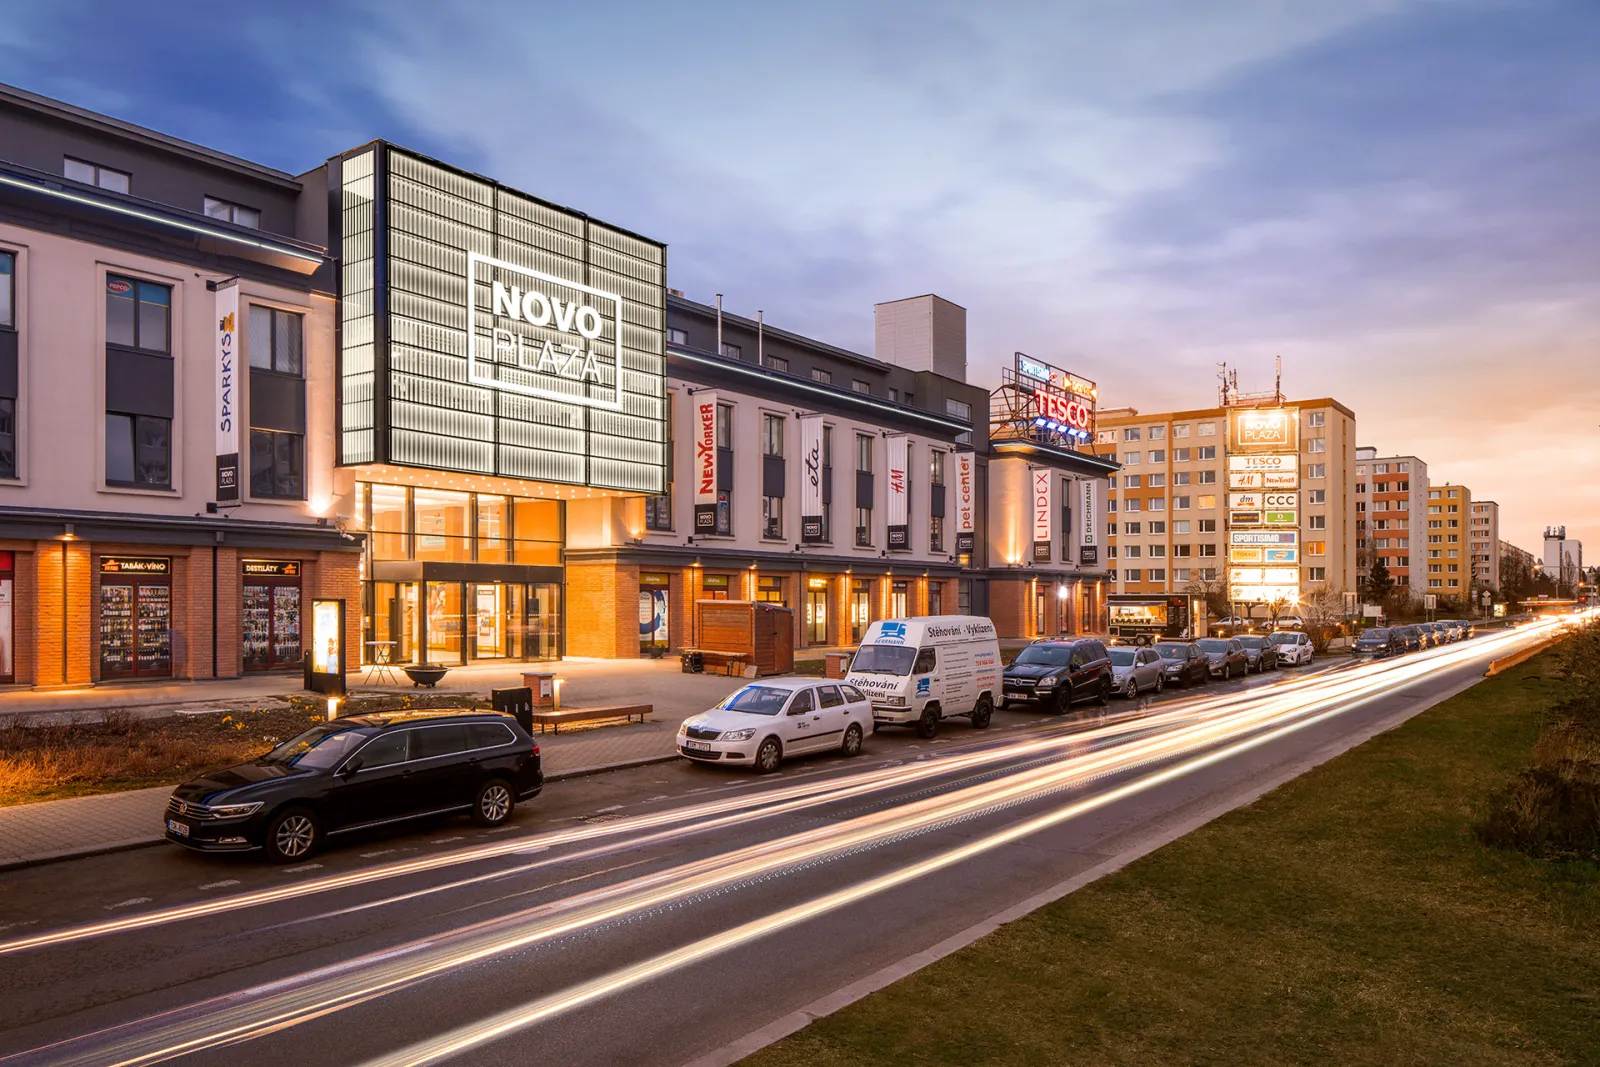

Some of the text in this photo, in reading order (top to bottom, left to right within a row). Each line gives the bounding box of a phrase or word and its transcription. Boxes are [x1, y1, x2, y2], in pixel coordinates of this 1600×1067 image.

[492, 280, 602, 340] NOVO
[493, 327, 604, 384] PLAZA
[220, 332, 232, 432] SPARKYS
[1034, 388, 1088, 428] TESCO
[1244, 430, 1281, 440] PLAZA
[805, 439, 820, 497] eta
[1244, 457, 1282, 465] TESCO
[960, 456, 972, 529] pet center
[1239, 494, 1254, 503] dm
[1267, 495, 1295, 505] CCC
[1036, 473, 1048, 539] LINDEX
[1233, 534, 1280, 543] SPORTISIMO
[927, 625, 961, 637] Stěhování
[862, 689, 886, 698] klízení
